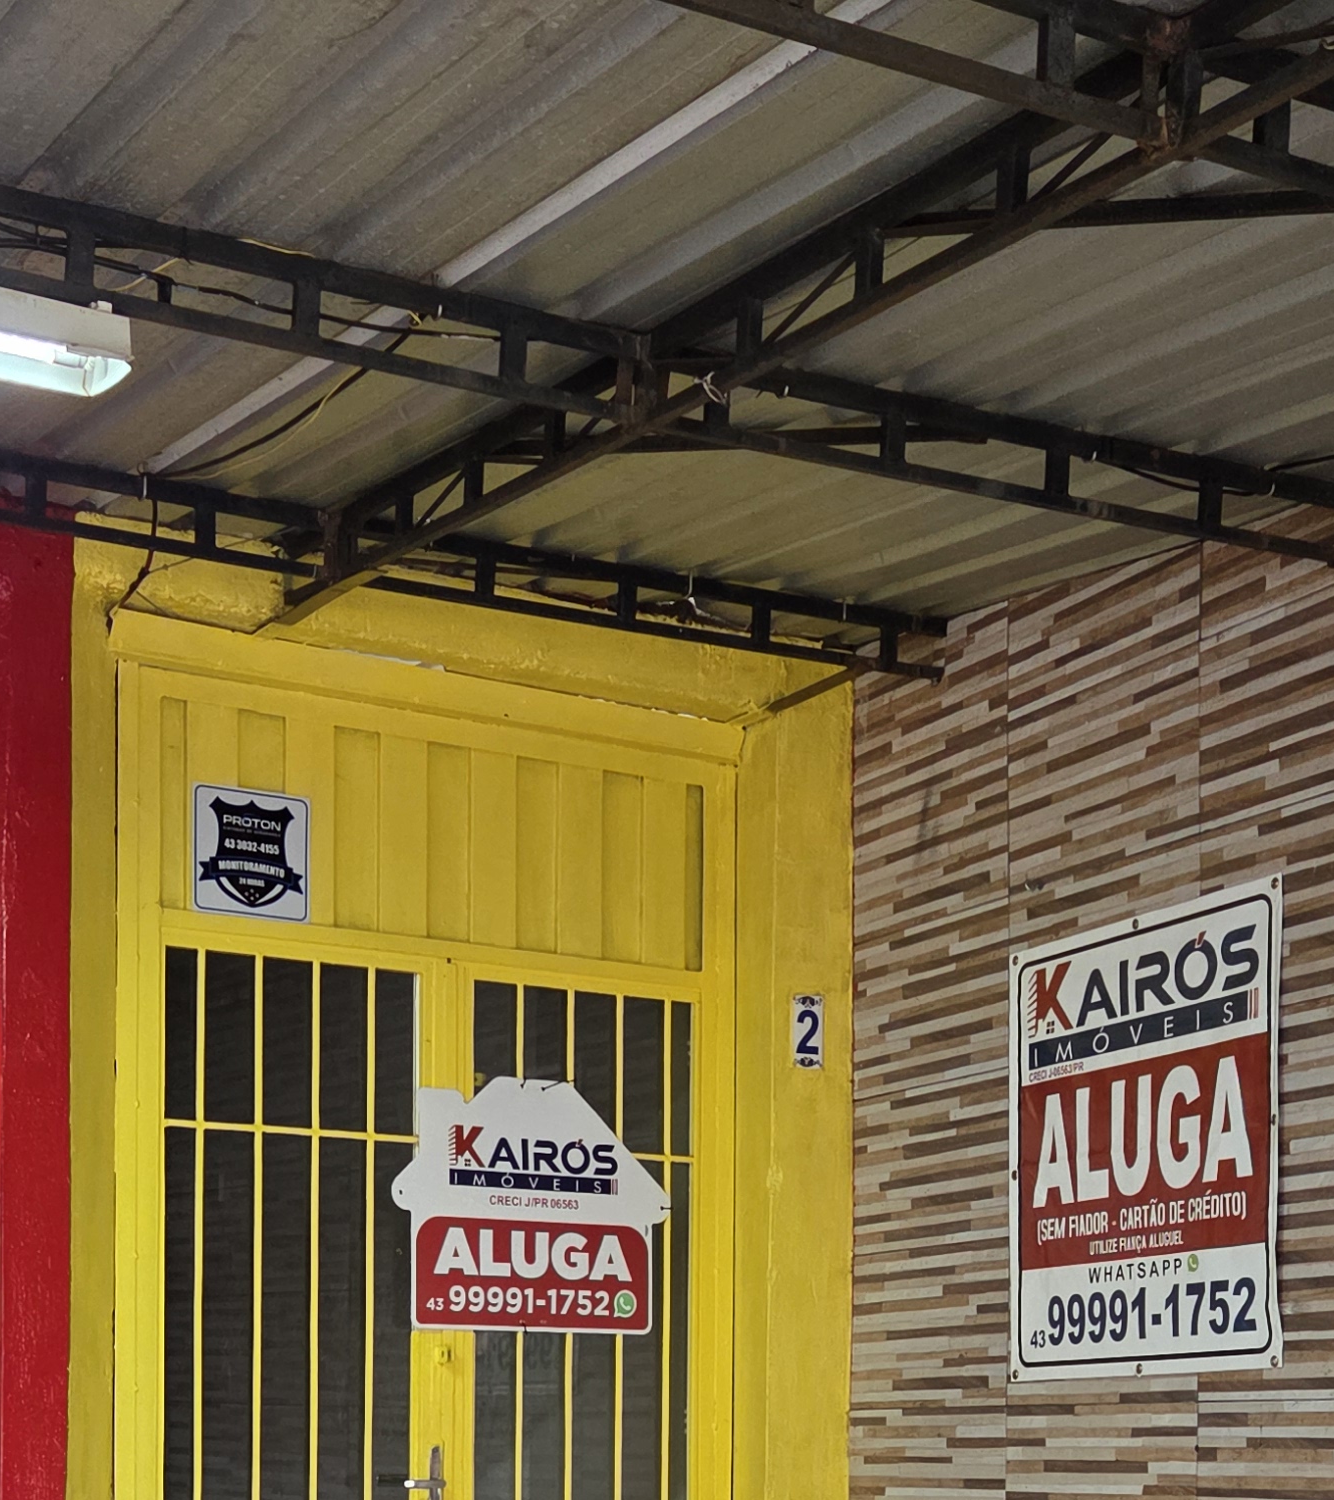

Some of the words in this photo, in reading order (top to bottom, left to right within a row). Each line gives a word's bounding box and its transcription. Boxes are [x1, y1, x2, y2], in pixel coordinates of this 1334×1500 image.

[223, 814, 281, 831] PROTON
[224, 838, 236, 849] 43
[218, 860, 285, 878] MONITORAMENTO
[1028, 924, 1259, 1034] KAIRÓS
[796, 1009, 819, 1055] 2
[1033, 1001, 1235, 1067] IMÓVEIS
[449, 1124, 618, 1175] KAIRÓS
[1033, 1055, 1254, 1208] ALUGA
[454, 1172, 602, 1193] IMÓVEIS
[489, 1194, 522, 1207] CRECI
[550, 1198, 580, 1210] 06563
[1037, 1215, 1066, 1245] (SEM
[1068, 1211, 1109, 1239] FIADOR
[1119, 1198, 1166, 1231] CARTÃO
[1169, 1200, 1186, 1225] DE
[1187, 1189, 1247, 1222] CRÉDITO)
[433, 1226, 633, 1282] ALUGA
[1089, 1237, 1118, 1256] UTILIZE
[1148, 1230, 1184, 1249] ALUGUEL
[1088, 1258, 1183, 1284] WHATSAPP
[426, 1297, 444, 1311] 43
[449, 1284, 610, 1316] 99991-1752
[1030, 1329, 1046, 1349] 43
[1048, 1276, 1258, 1346] 99991-1752
